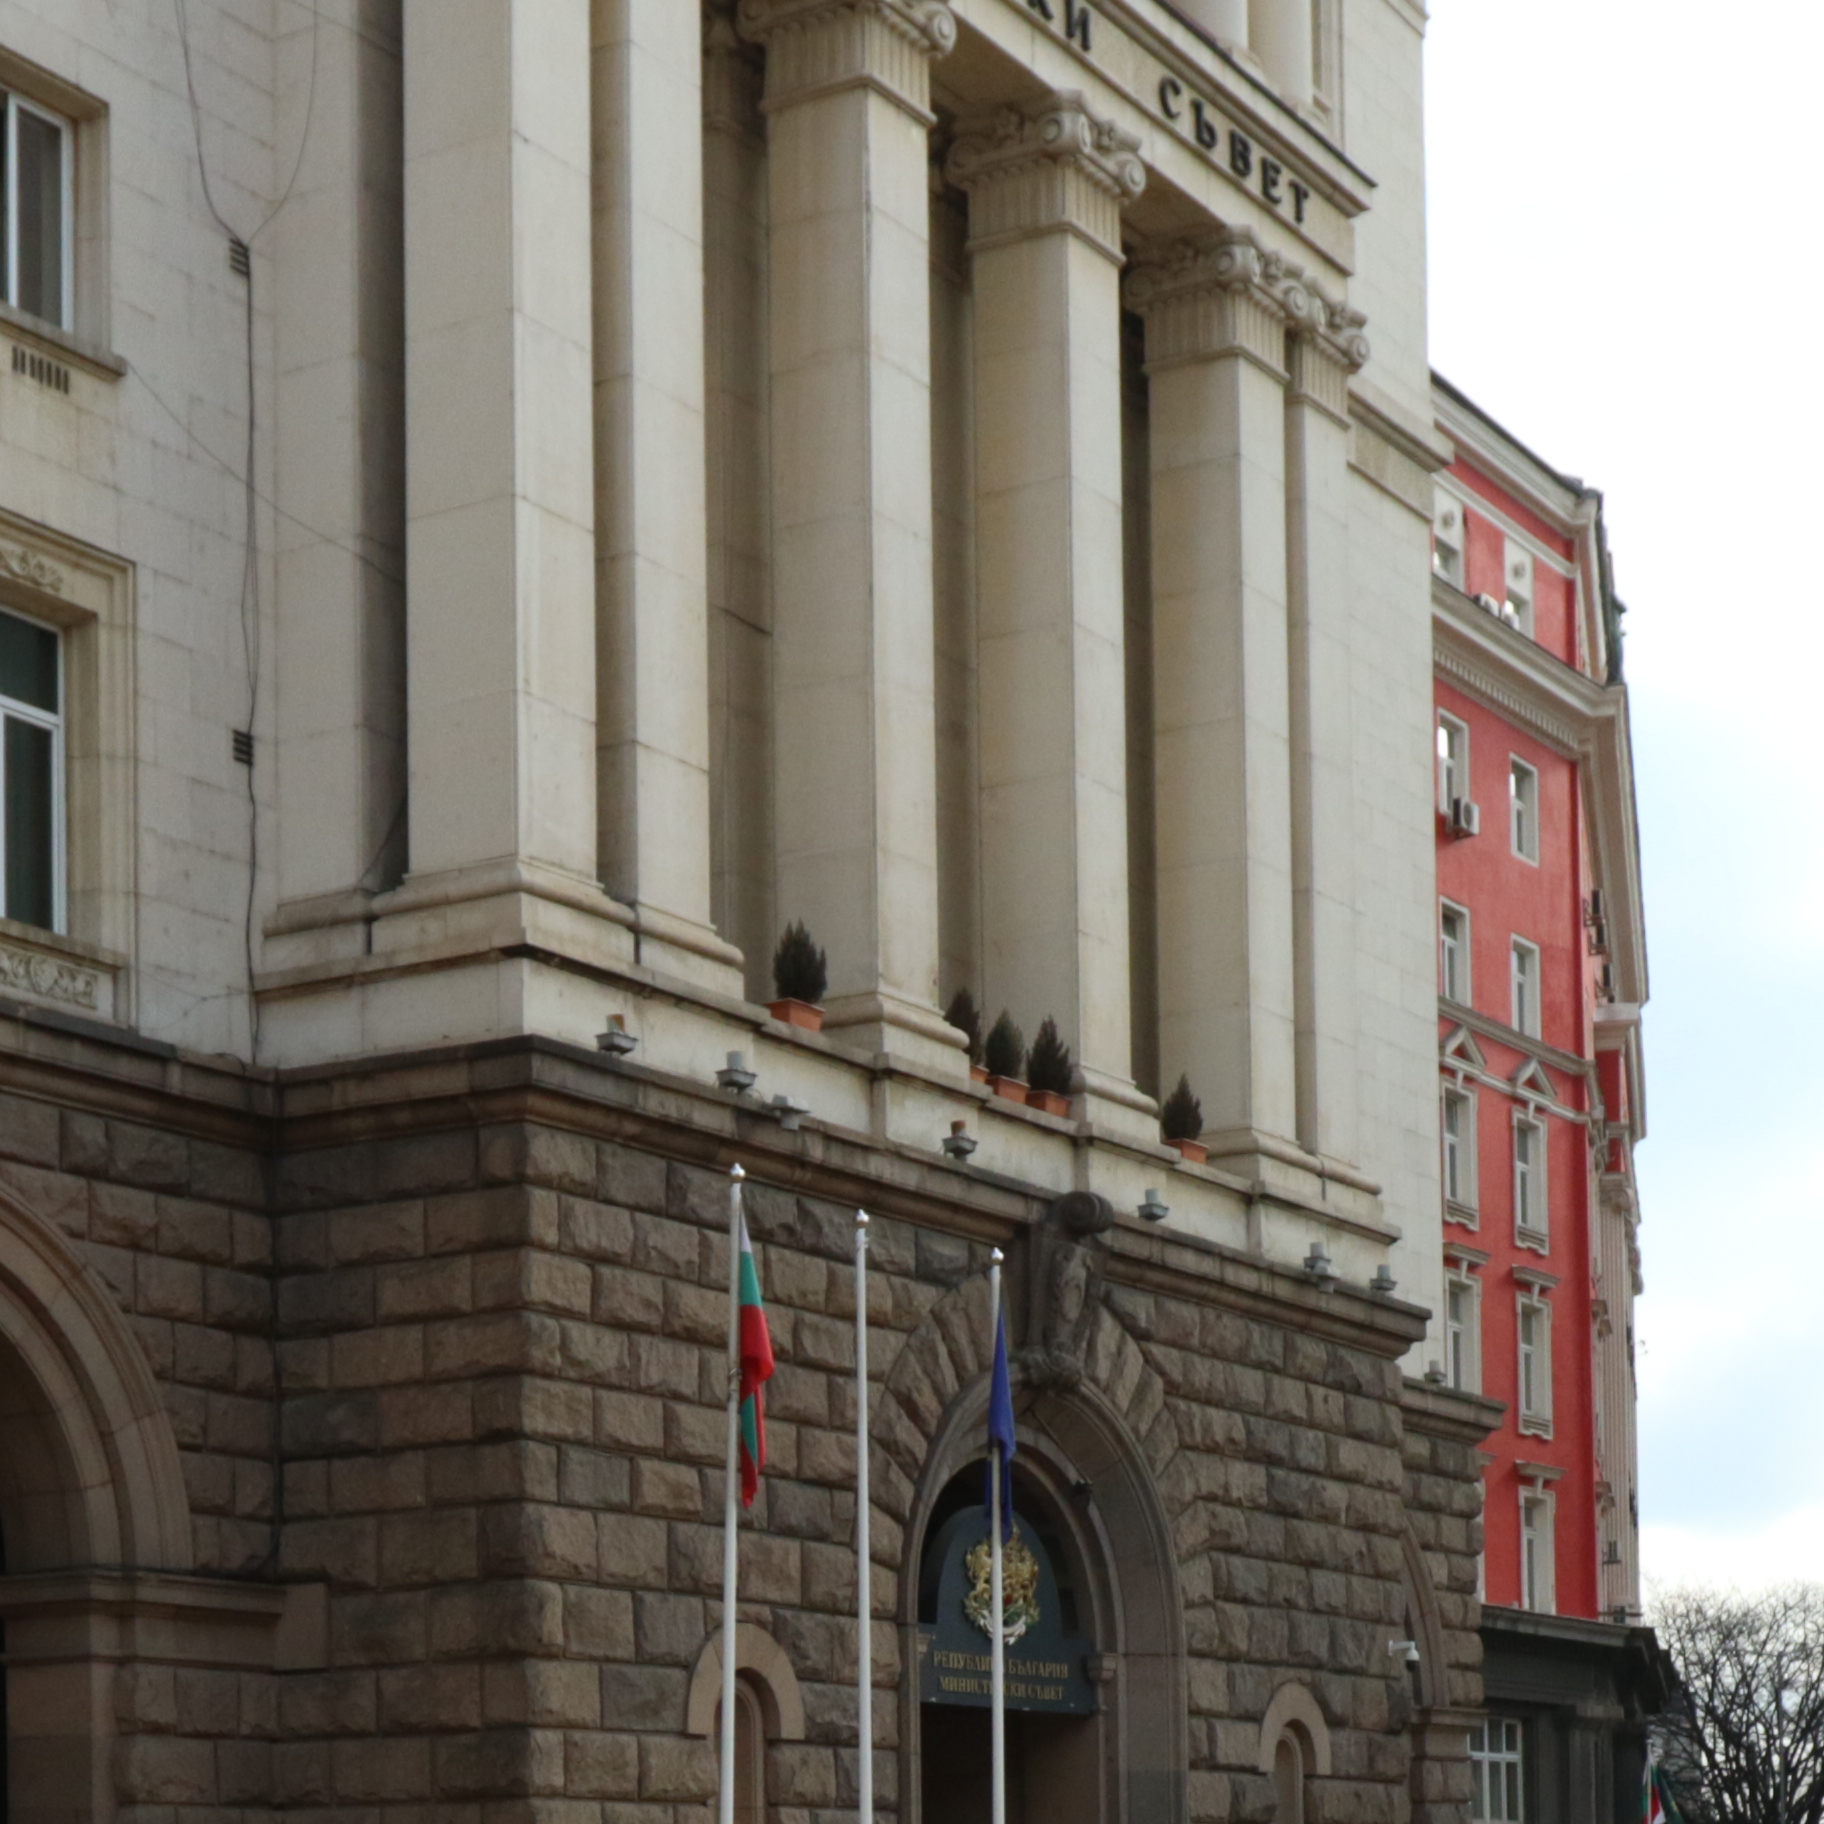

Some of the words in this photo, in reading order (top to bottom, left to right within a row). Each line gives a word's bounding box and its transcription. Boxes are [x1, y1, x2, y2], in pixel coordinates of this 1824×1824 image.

[1158, 75, 1310, 224] СЪВЕТ
[1008, 1657, 1069, 1679] БЪЛГАРИЯ
[1027, 1683, 1065, 1700] СЪВЕТ
